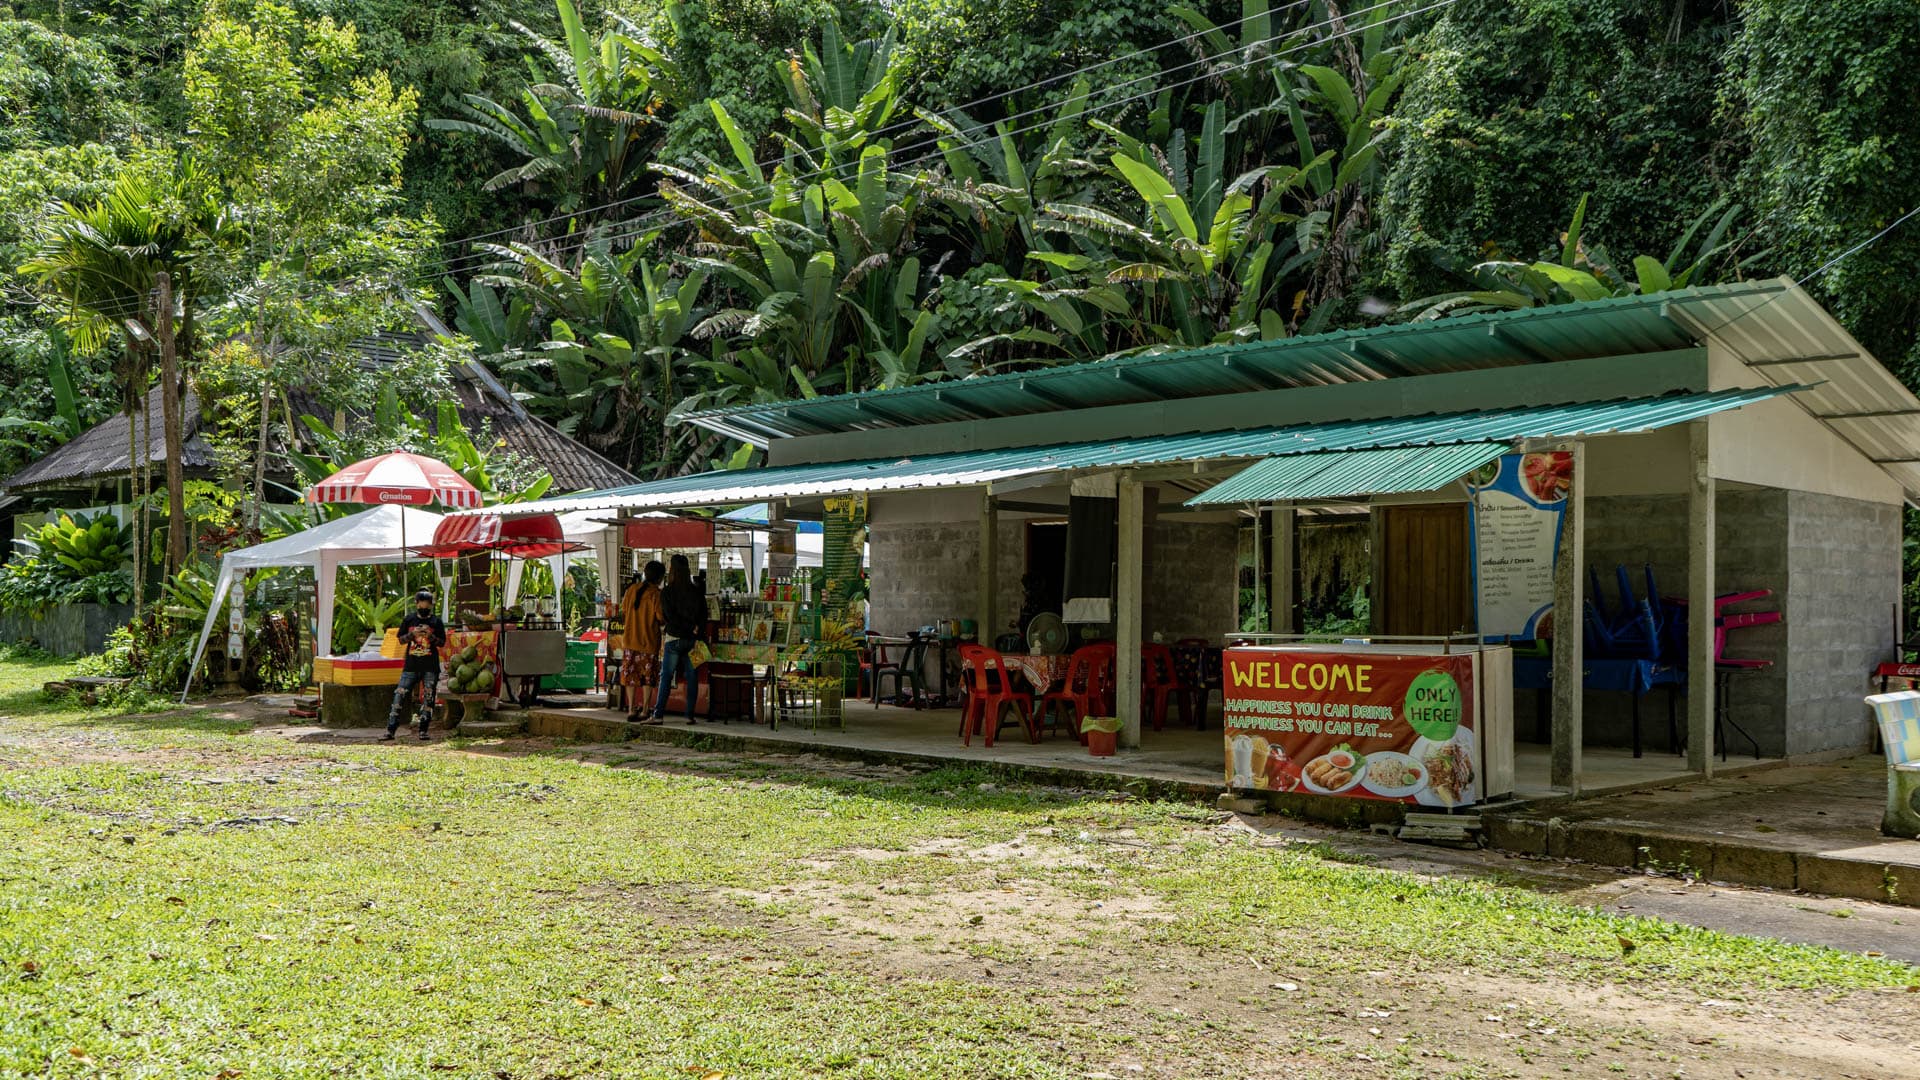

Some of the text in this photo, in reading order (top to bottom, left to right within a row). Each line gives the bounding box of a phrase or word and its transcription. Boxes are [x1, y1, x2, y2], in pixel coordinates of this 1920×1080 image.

[379, 491, 412, 502] Carnation
[1230, 660, 1373, 693] WELCOME
[1415, 687, 1457, 703] ONLY
[1293, 701, 1321, 717] YOU
[1323, 703, 1350, 718] CAN
[1352, 704, 1394, 721] DRINK
[1228, 715, 1294, 732] HAPPINESS
[1296, 719, 1323, 734] YOU
[1325, 720, 1352, 736] CAN
